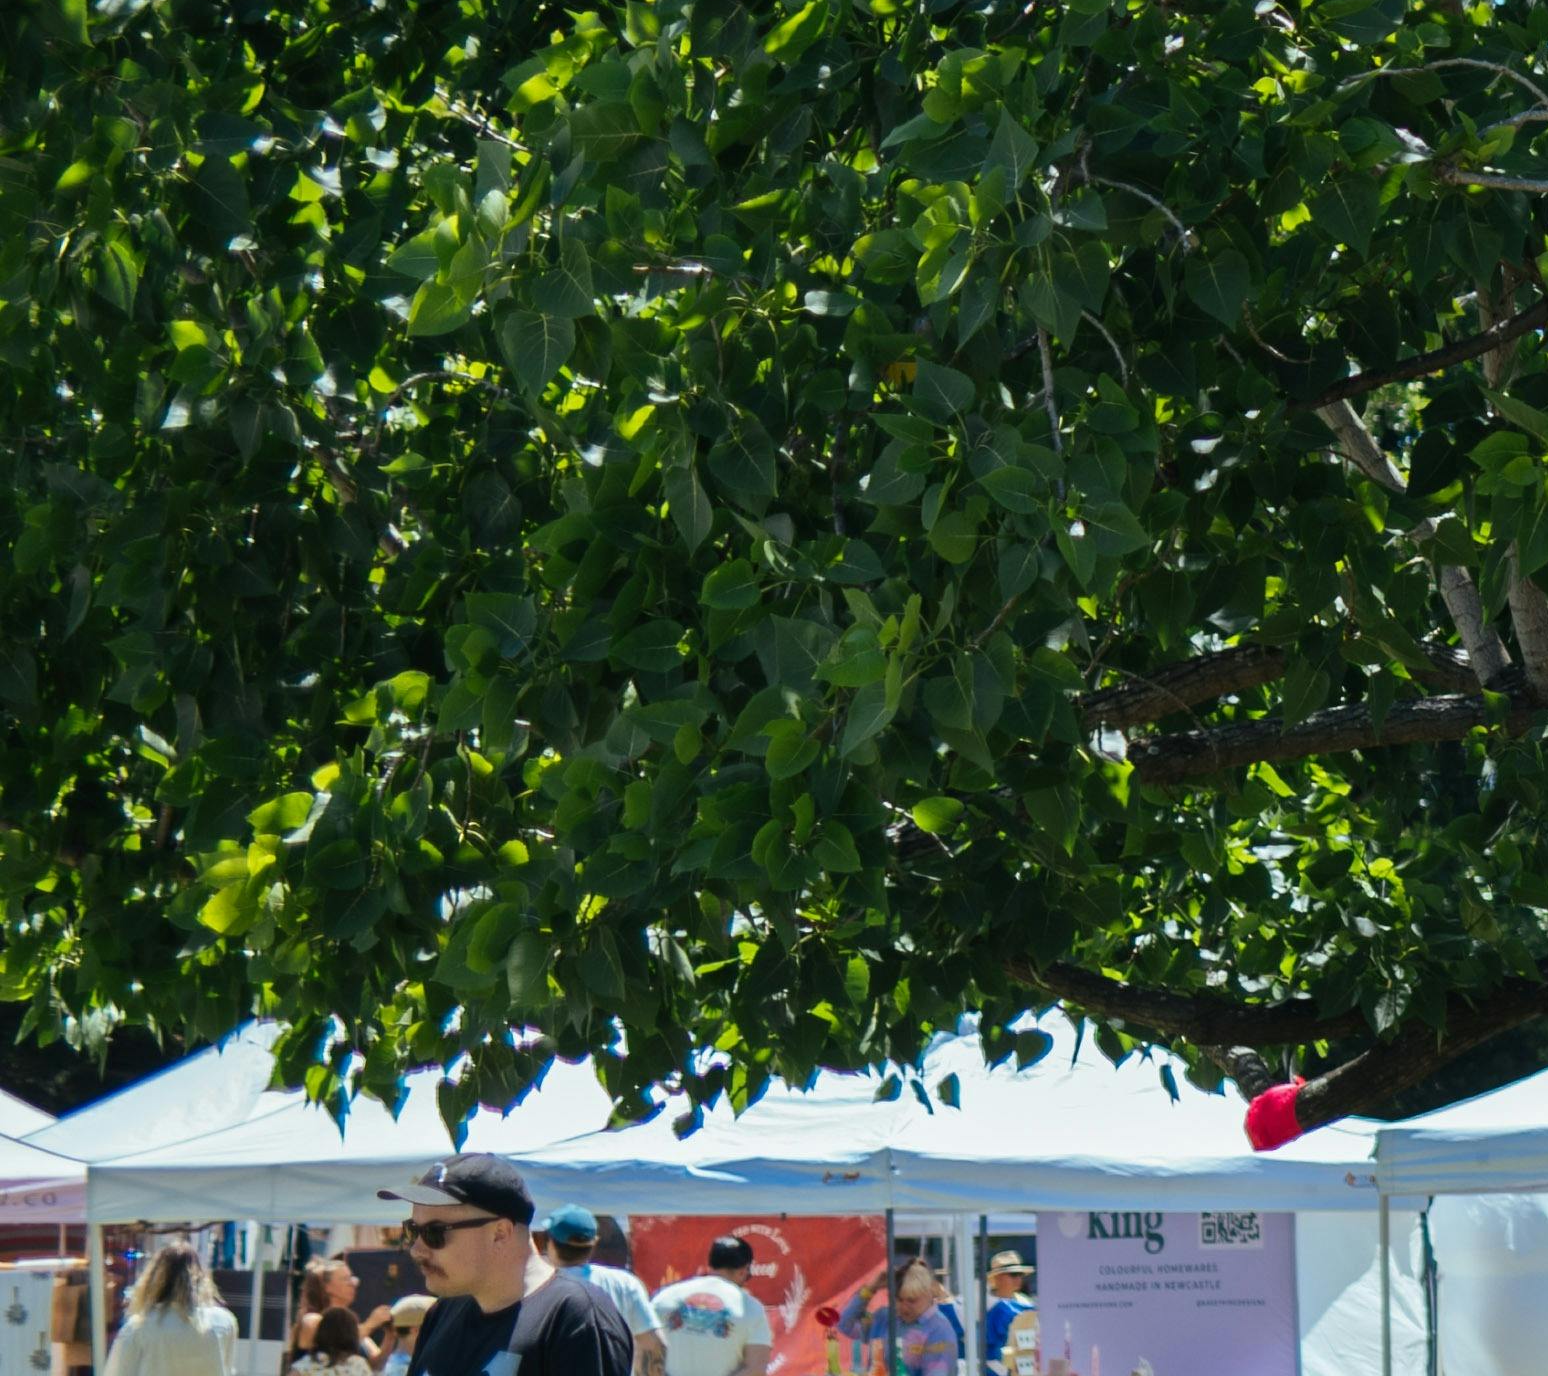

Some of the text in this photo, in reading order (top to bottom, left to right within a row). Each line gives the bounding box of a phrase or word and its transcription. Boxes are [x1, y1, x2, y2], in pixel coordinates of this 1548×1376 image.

[1087, 1212, 1165, 1254] king
[1099, 1263, 1218, 1276] COLOURFUL HOMEWARES
[1096, 1280, 1221, 1291] HANDMADE IN NEWCASTLE
